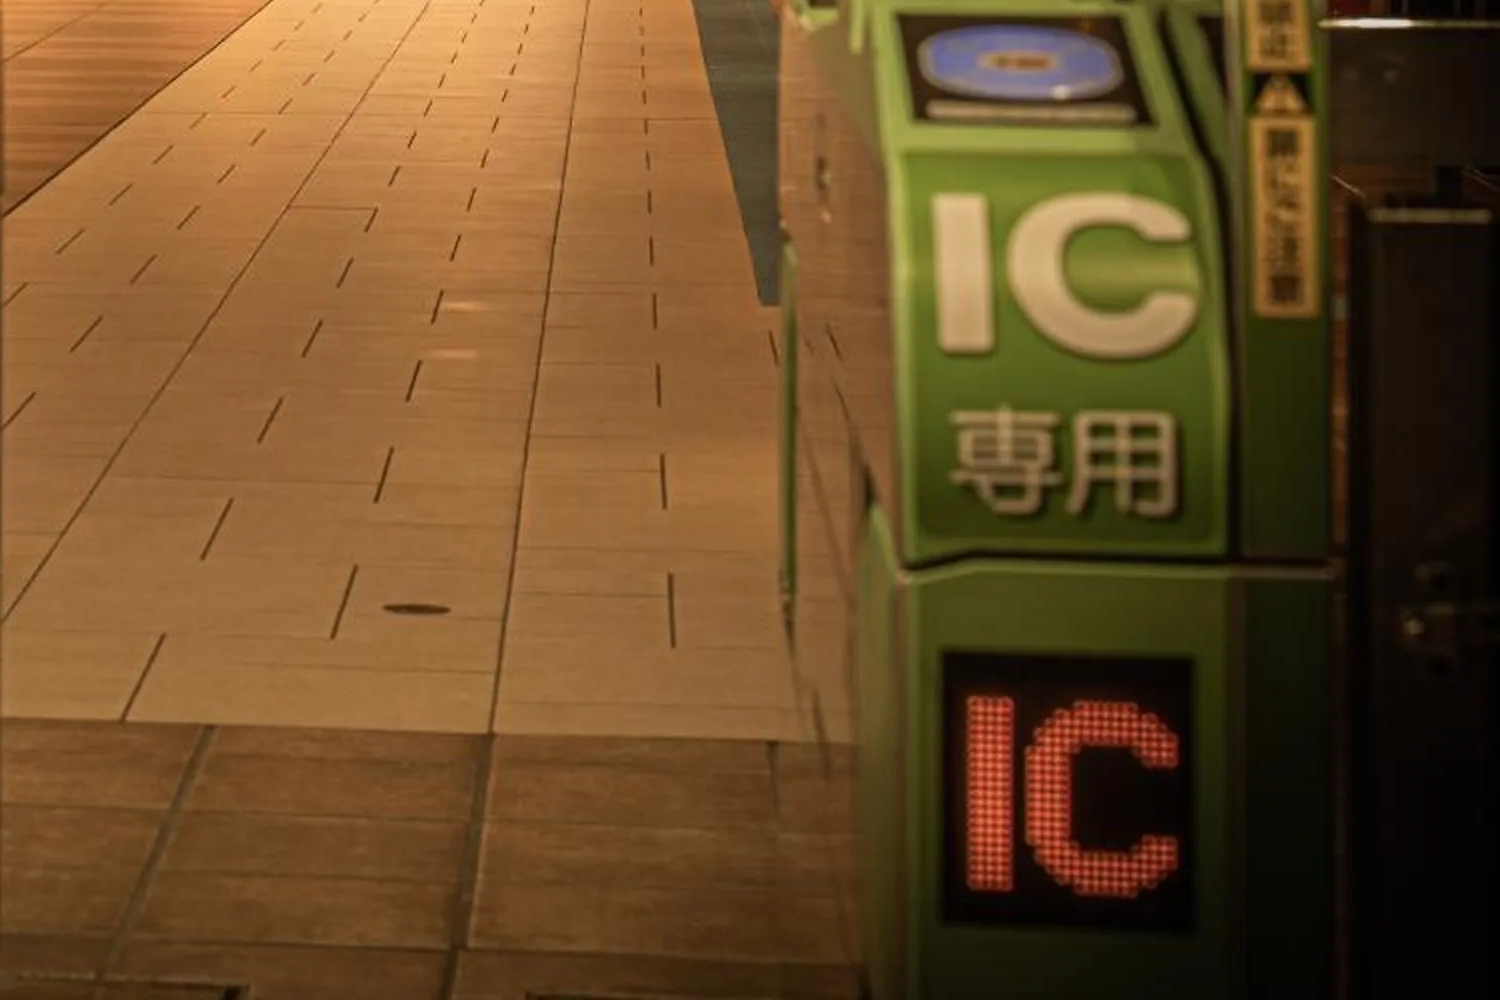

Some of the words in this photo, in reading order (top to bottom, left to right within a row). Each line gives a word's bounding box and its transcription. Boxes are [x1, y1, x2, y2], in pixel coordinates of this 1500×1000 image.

[931, 191, 1199, 360] IC
[949, 405, 1179, 517] 専用
[966, 695, 1179, 898] IC
